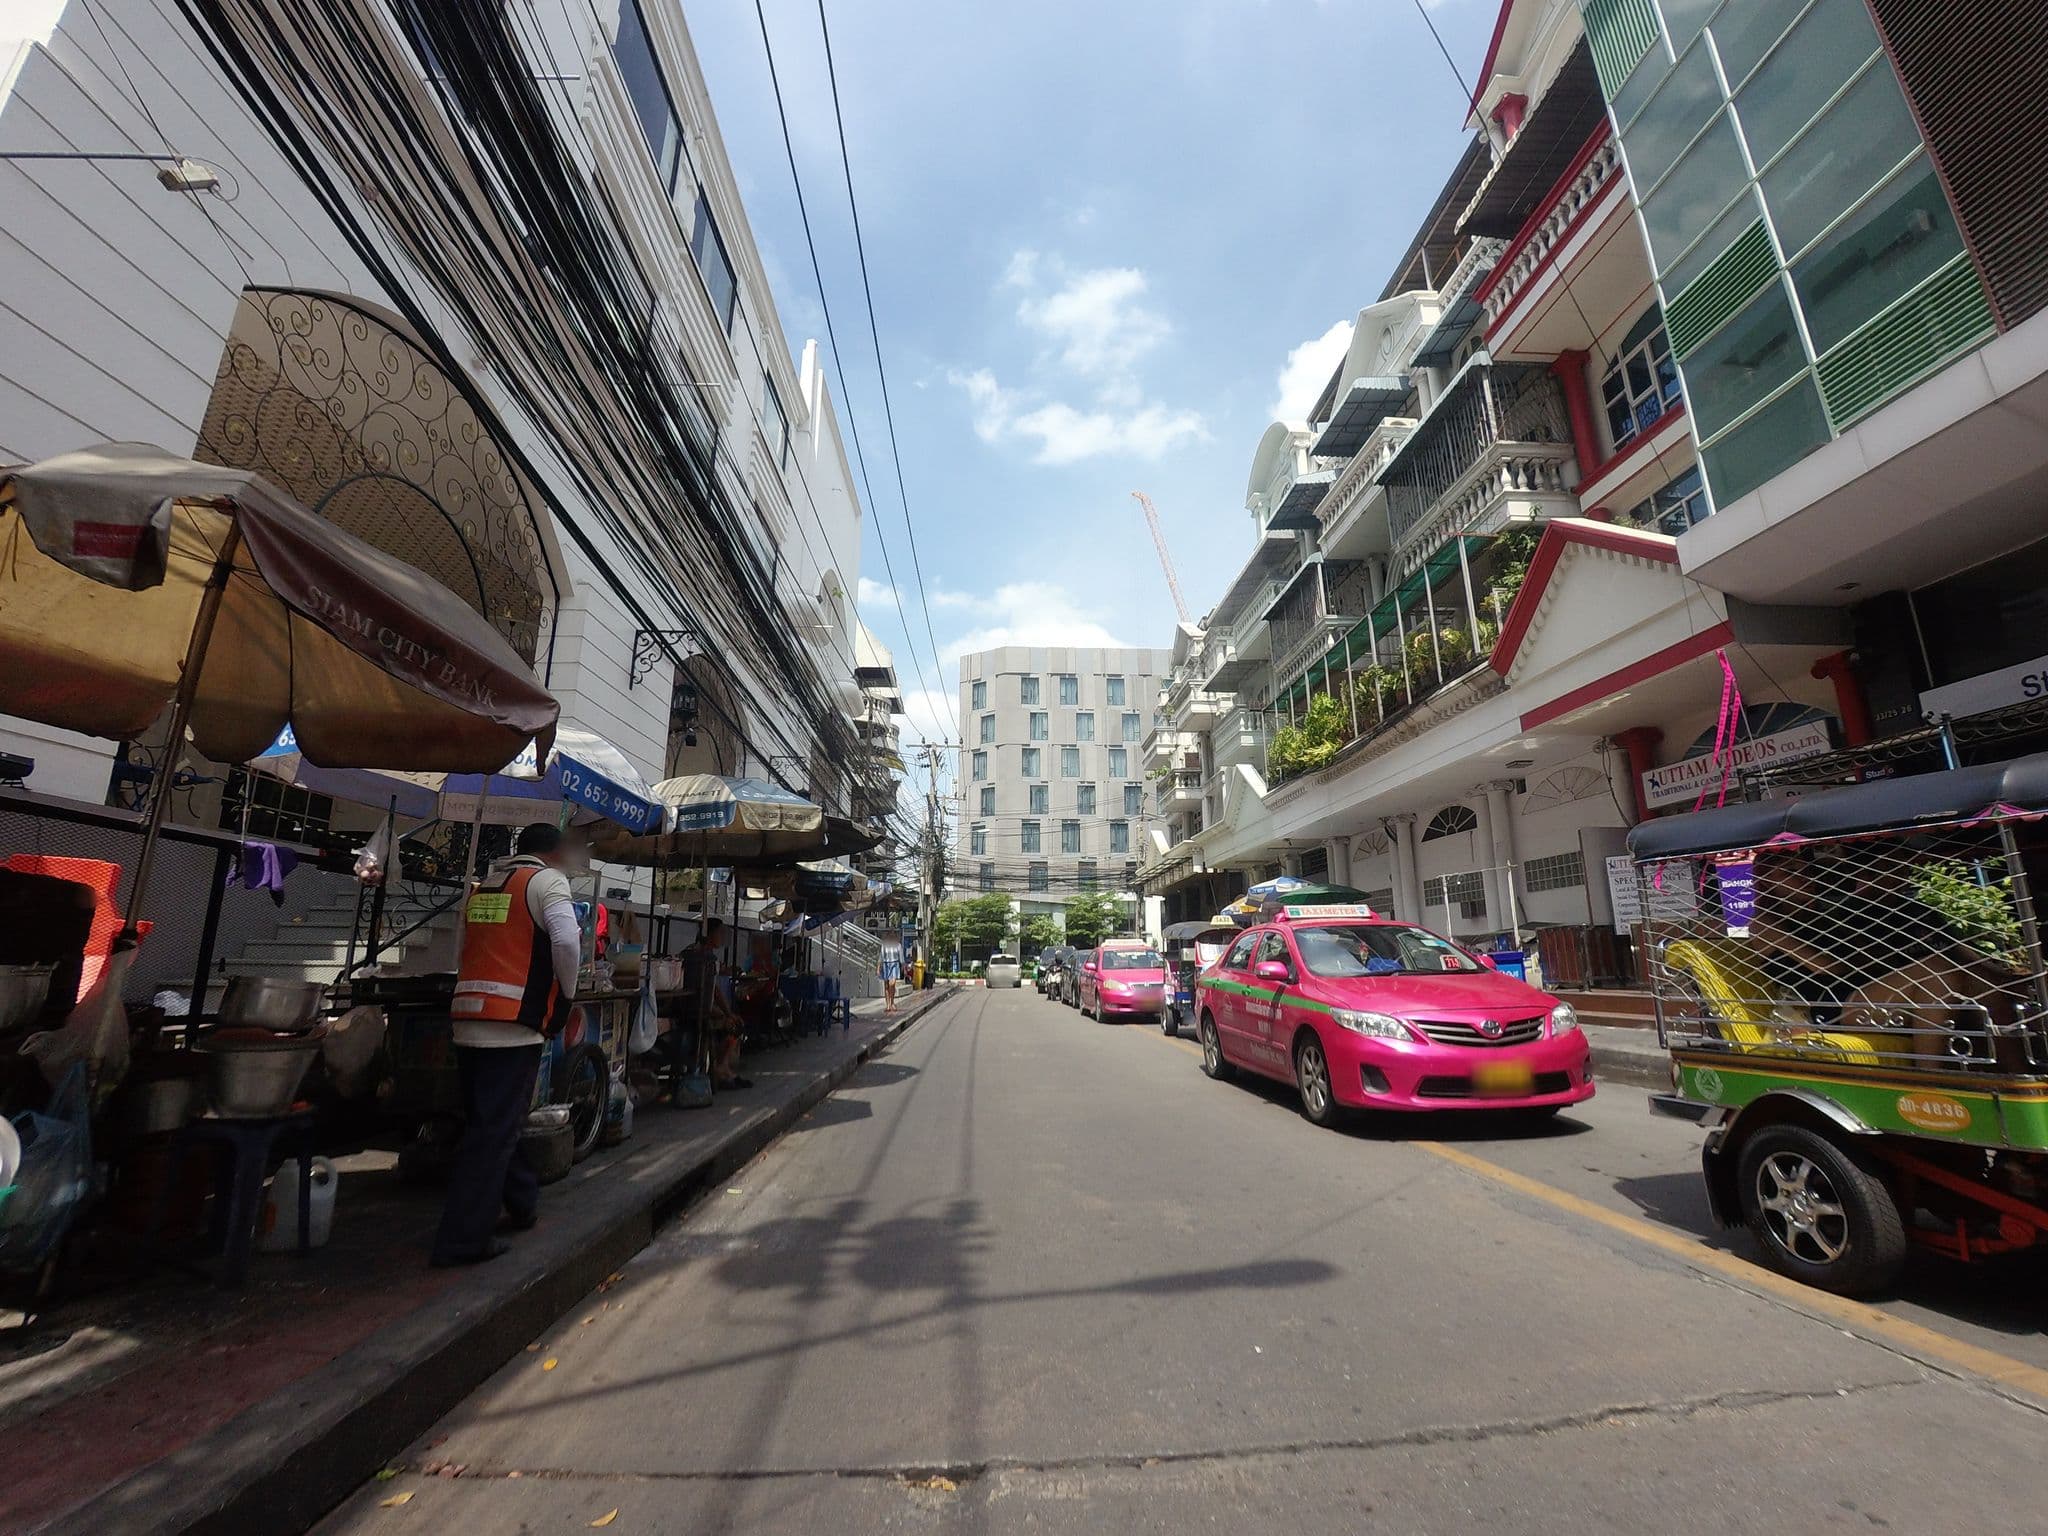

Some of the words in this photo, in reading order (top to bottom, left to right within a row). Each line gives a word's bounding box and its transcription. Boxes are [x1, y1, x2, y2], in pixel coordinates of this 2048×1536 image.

[303, 586, 374, 638] SIAM
[377, 627, 437, 670] CITY
[439, 661, 498, 709] BANK
[1652, 783, 1692, 798] TRADITIONAL
[1658, 759, 1708, 786] UTTAM
[562, 770, 579, 792] 02
[584, 782, 608, 807] 652
[614, 797, 645, 823] 9999
